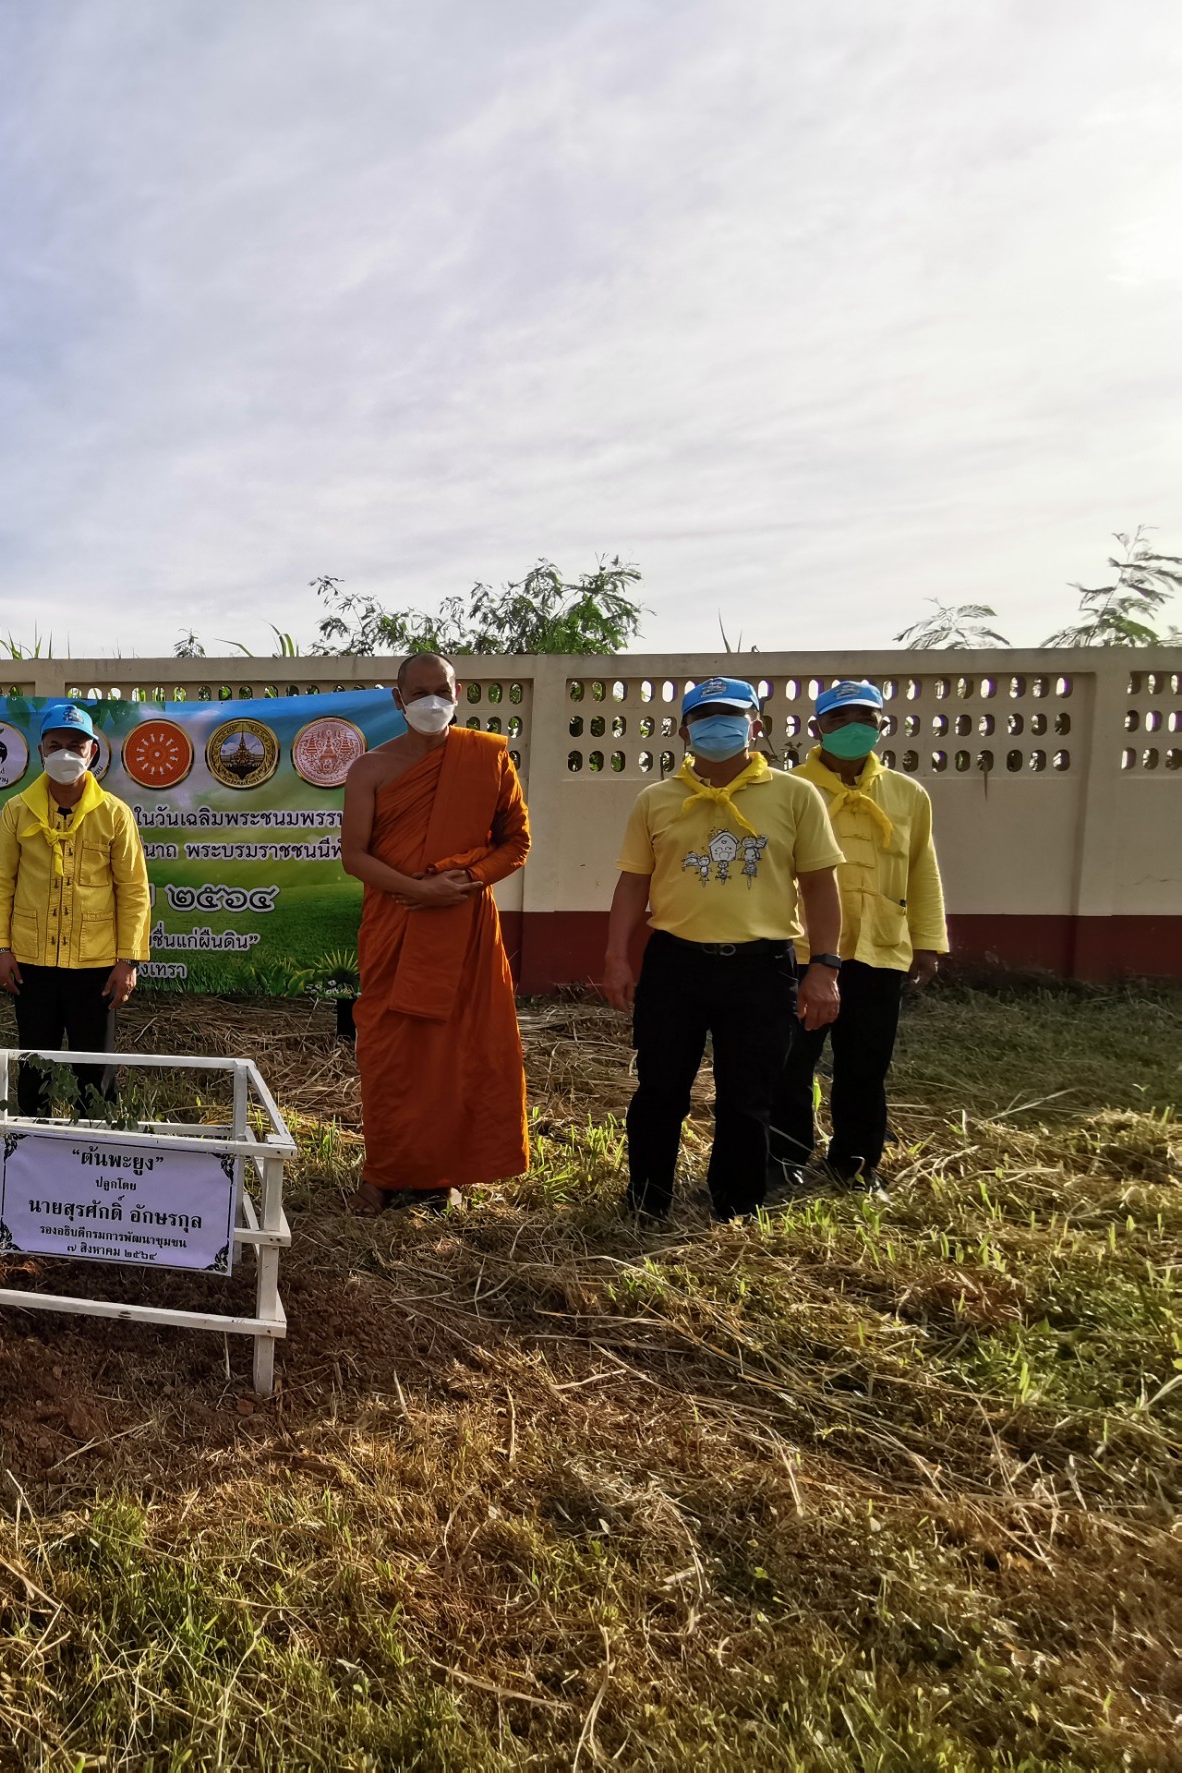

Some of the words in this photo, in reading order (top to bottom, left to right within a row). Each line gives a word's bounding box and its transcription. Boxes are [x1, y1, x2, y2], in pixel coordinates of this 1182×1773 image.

[166, 885, 277, 909] ๒๕๖๔
[149, 921, 259, 949] ชื่นแก่ผืนดิน”
[72, 1145, 164, 1176] “ต้นพะยูง”
[95, 1176, 137, 1191] ปลูกโดย
[29, 1195, 124, 1222] นายสุรศักดิ์
[130, 1203, 202, 1233] อักษรกุล
[80, 1241, 121, 1257] สิงหาคม
